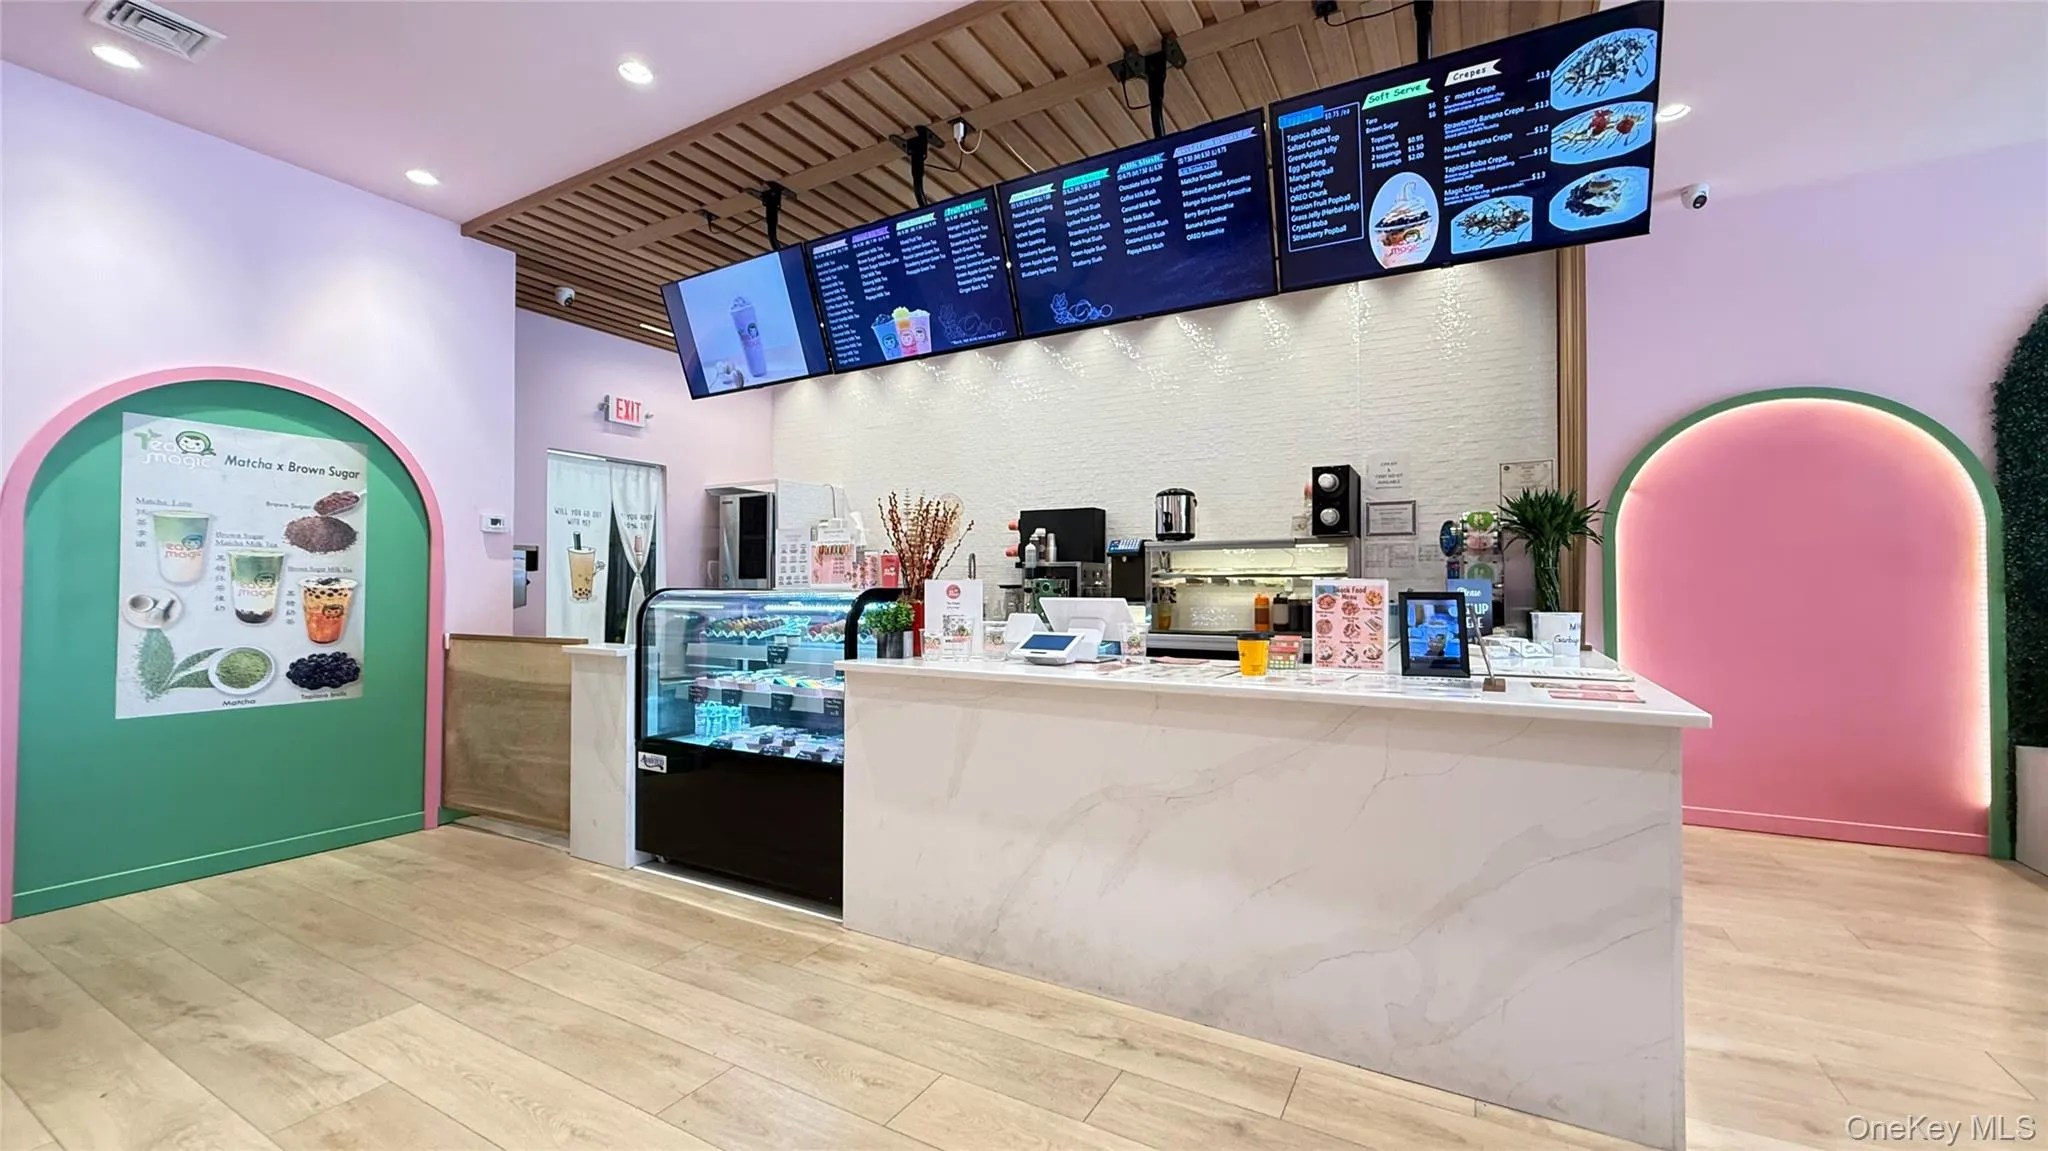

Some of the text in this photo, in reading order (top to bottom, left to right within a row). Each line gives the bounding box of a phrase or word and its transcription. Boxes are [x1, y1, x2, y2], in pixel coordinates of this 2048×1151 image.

[1453, 67, 1485, 80] Crepes
[1535, 70, 1550, 79] $13
[1368, 84, 1421, 103] Soft Serve
[1454, 89, 1475, 99] mores
[1475, 85, 1495, 94] Crepe
[1534, 99, 1549, 109] $13
[1443, 106, 1524, 130] Strawberry Banana Crepe
[1286, 125, 1330, 142] Tapioca (Boba)
[1365, 121, 1398, 133] Brown Sugar
[1534, 124, 1548, 133] $12
[1287, 134, 1339, 152] Salted Cream Top
[1371, 133, 1394, 143] Topping
[1444, 133, 1512, 152] Nutella Banana Crepe
[1323, 145, 1336, 154] Jelly
[1375, 141, 1398, 150] topping
[1532, 146, 1547, 156] $13
[1375, 149, 1401, 159] toppings
[1288, 159, 1325, 173] Egg Pudding
[1376, 158, 1401, 167] toppings
[1444, 155, 1507, 172] Tapioca Boba Crepe
[1180, 170, 1222, 184] Matcha Smoothie
[1289, 166, 1333, 182] Mango Popball
[1531, 171, 1545, 180] $13
[1181, 175, 1250, 196] Strawberry Banana Smoothie
[1289, 179, 1323, 193] Lychee Jelly
[1444, 183, 1483, 195] Magic Crepe
[1119, 194, 1134, 202] Coffee
[1182, 187, 1251, 207] Mango Strawberry Smoothie
[1290, 188, 1327, 202] OREO Chunk
[1210, 202, 1233, 212] Smoothie
[1290, 193, 1350, 211] Passion Fruit Popball
[1307, 210, 1320, 218] Jelly
[1321, 205, 1343, 216] (Herbal
[1343, 202, 1359, 211] Jelly)
[1185, 216, 1226, 229] Banana Smoothie
[1292, 219, 1327, 231] Crystal Boba
[1201, 228, 1224, 237] Smoothie
[1292, 224, 1346, 241] Strawberry Popball
[616, 397, 642, 423] EXIT
[142, 451, 212, 470] magic
[224, 455, 360, 481] Matcha x Brown Sugar
[554, 506, 602, 518] WILL YOU GO OUT
[1352, 586, 1367, 594] Food
[1474, 603, 1489, 615] UP
[222, 698, 256, 706] Matcha
